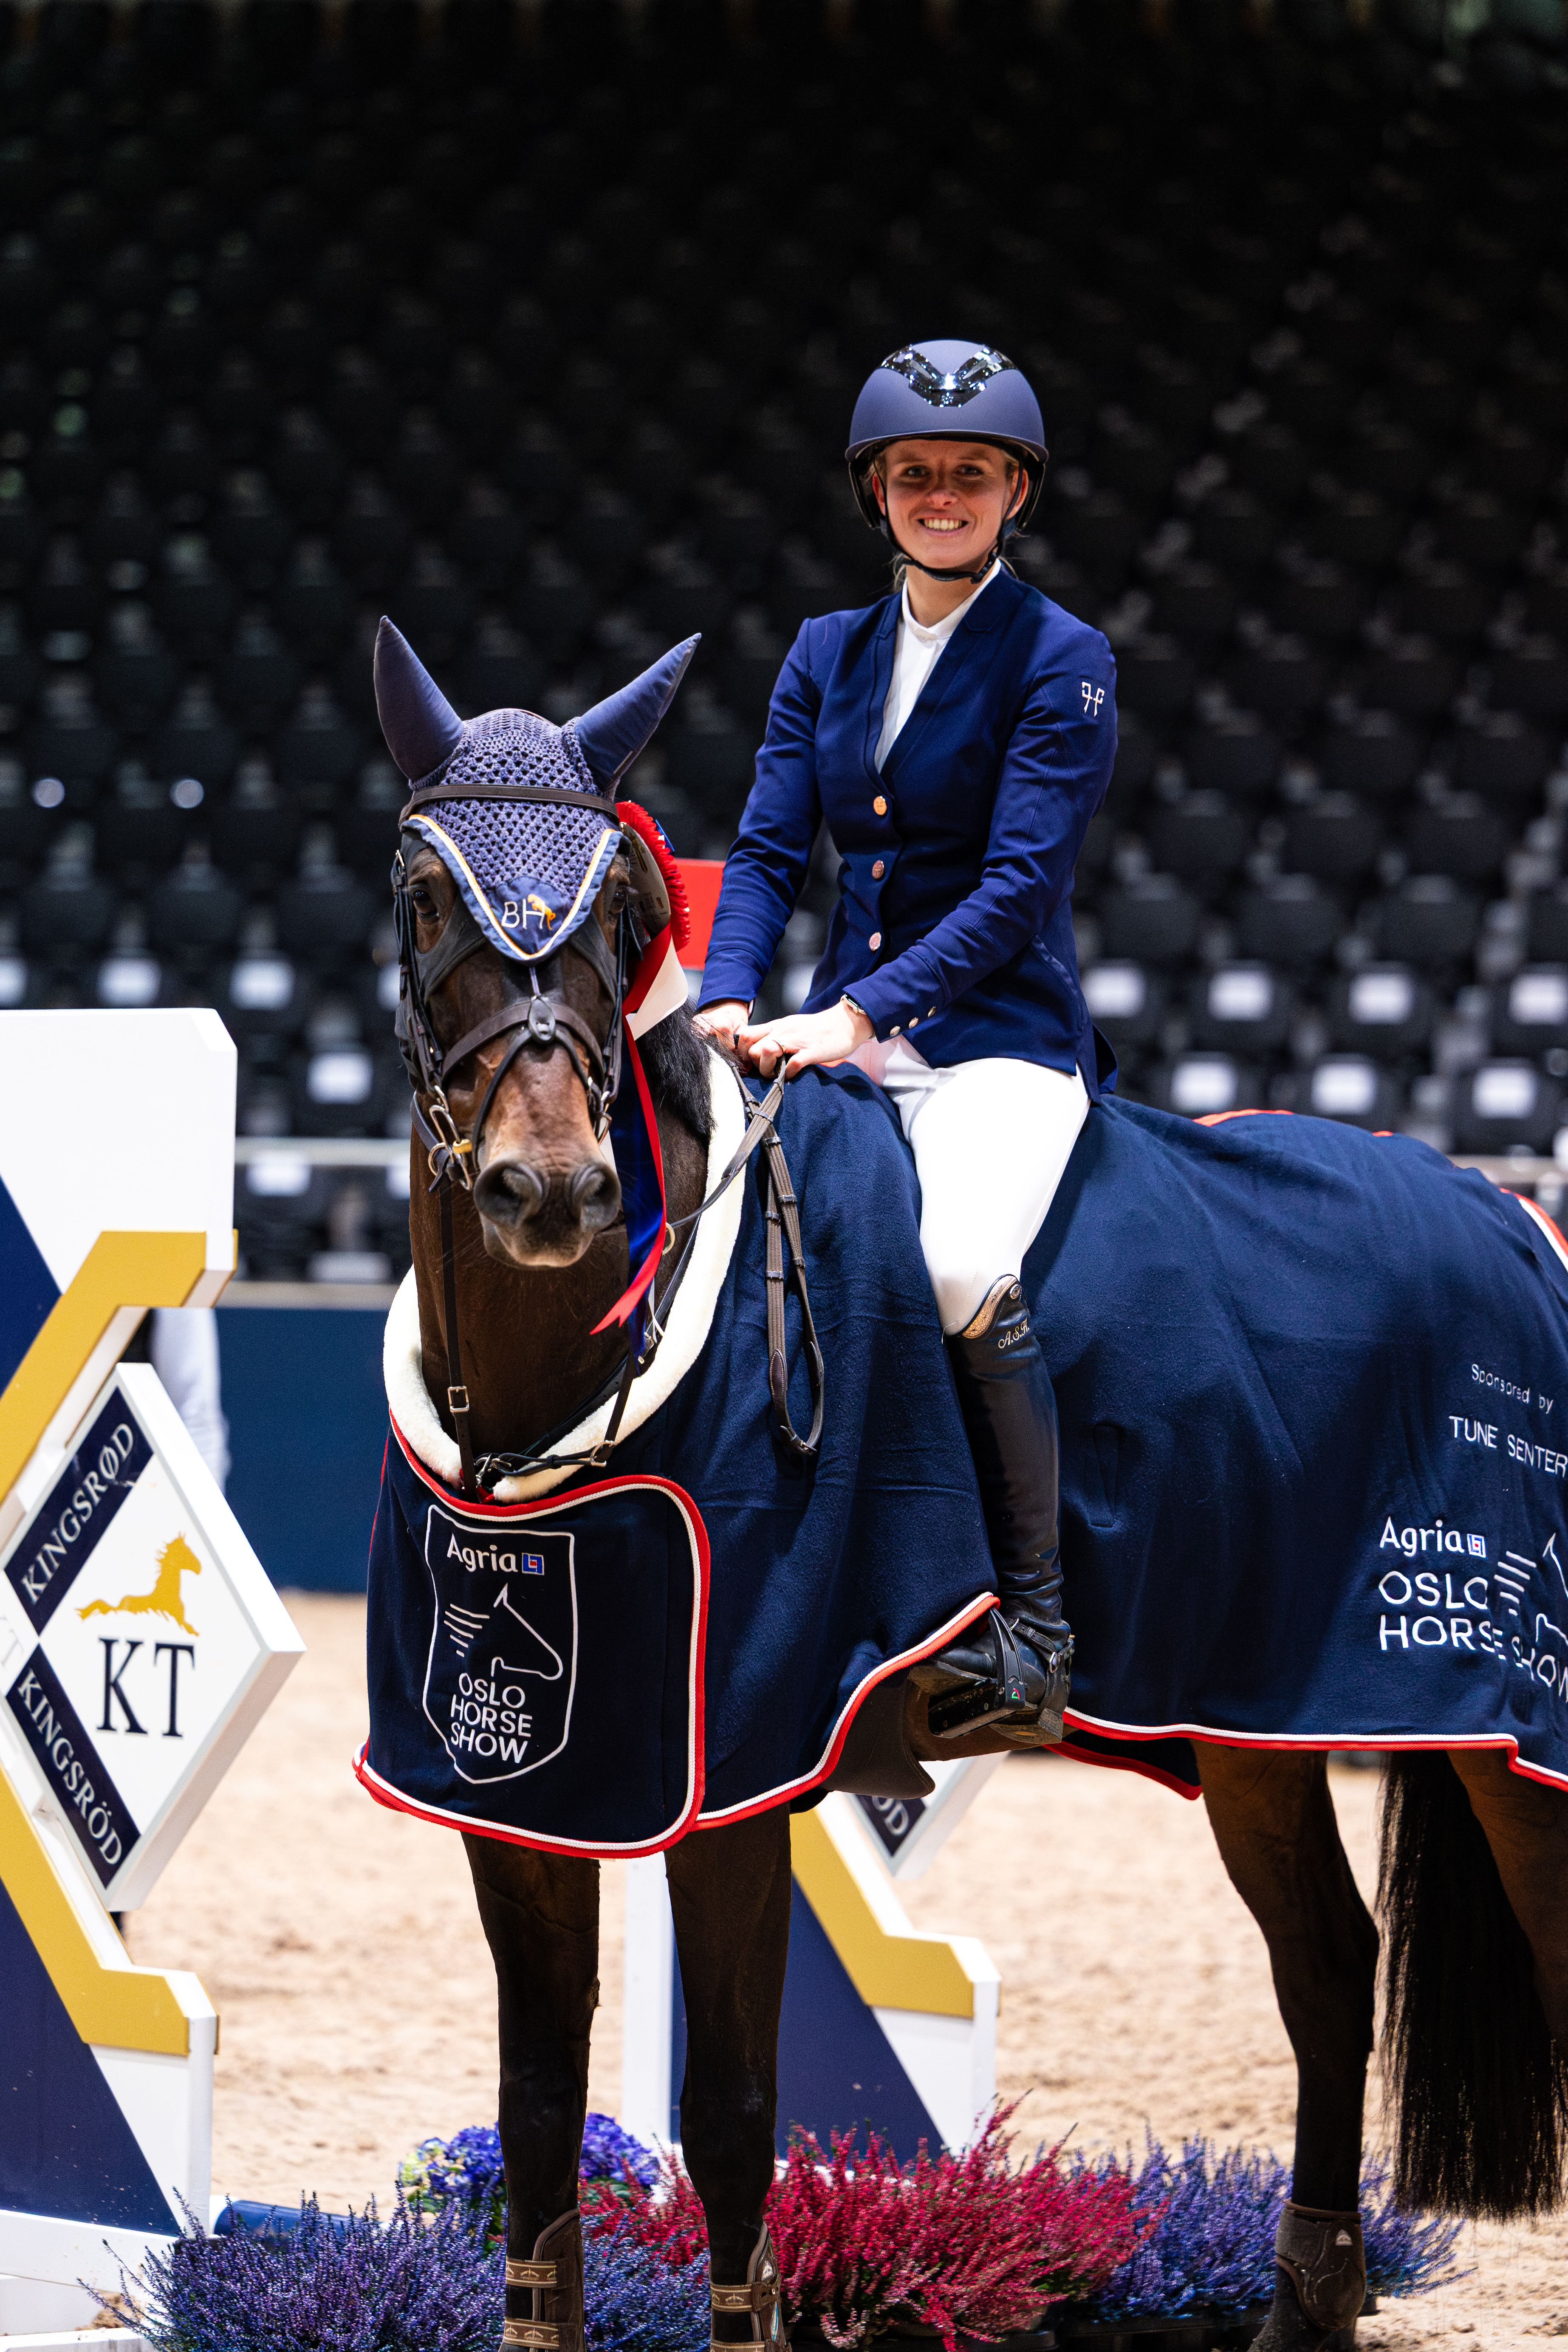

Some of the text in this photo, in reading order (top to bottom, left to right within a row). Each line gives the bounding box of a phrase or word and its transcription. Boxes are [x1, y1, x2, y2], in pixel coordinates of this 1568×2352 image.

[1539, 1392, 1554, 1415] by
[1449, 1415, 1568, 1478] TUNE SENTER
[21, 1423, 134, 1605] KINGSRØD
[447, 1533, 519, 1573] Agria
[1379, 1516, 1464, 1558] Agria
[1378, 1571, 1488, 1610] OSLO
[1379, 1614, 1506, 1660] HORSE
[96, 1637, 196, 1740] KT
[458, 1672, 525, 1709] OSLO
[450, 1694, 533, 1738] HORSE
[450, 1722, 528, 1764] SHOW
[17, 1669, 123, 1866] KINGSRÖD
